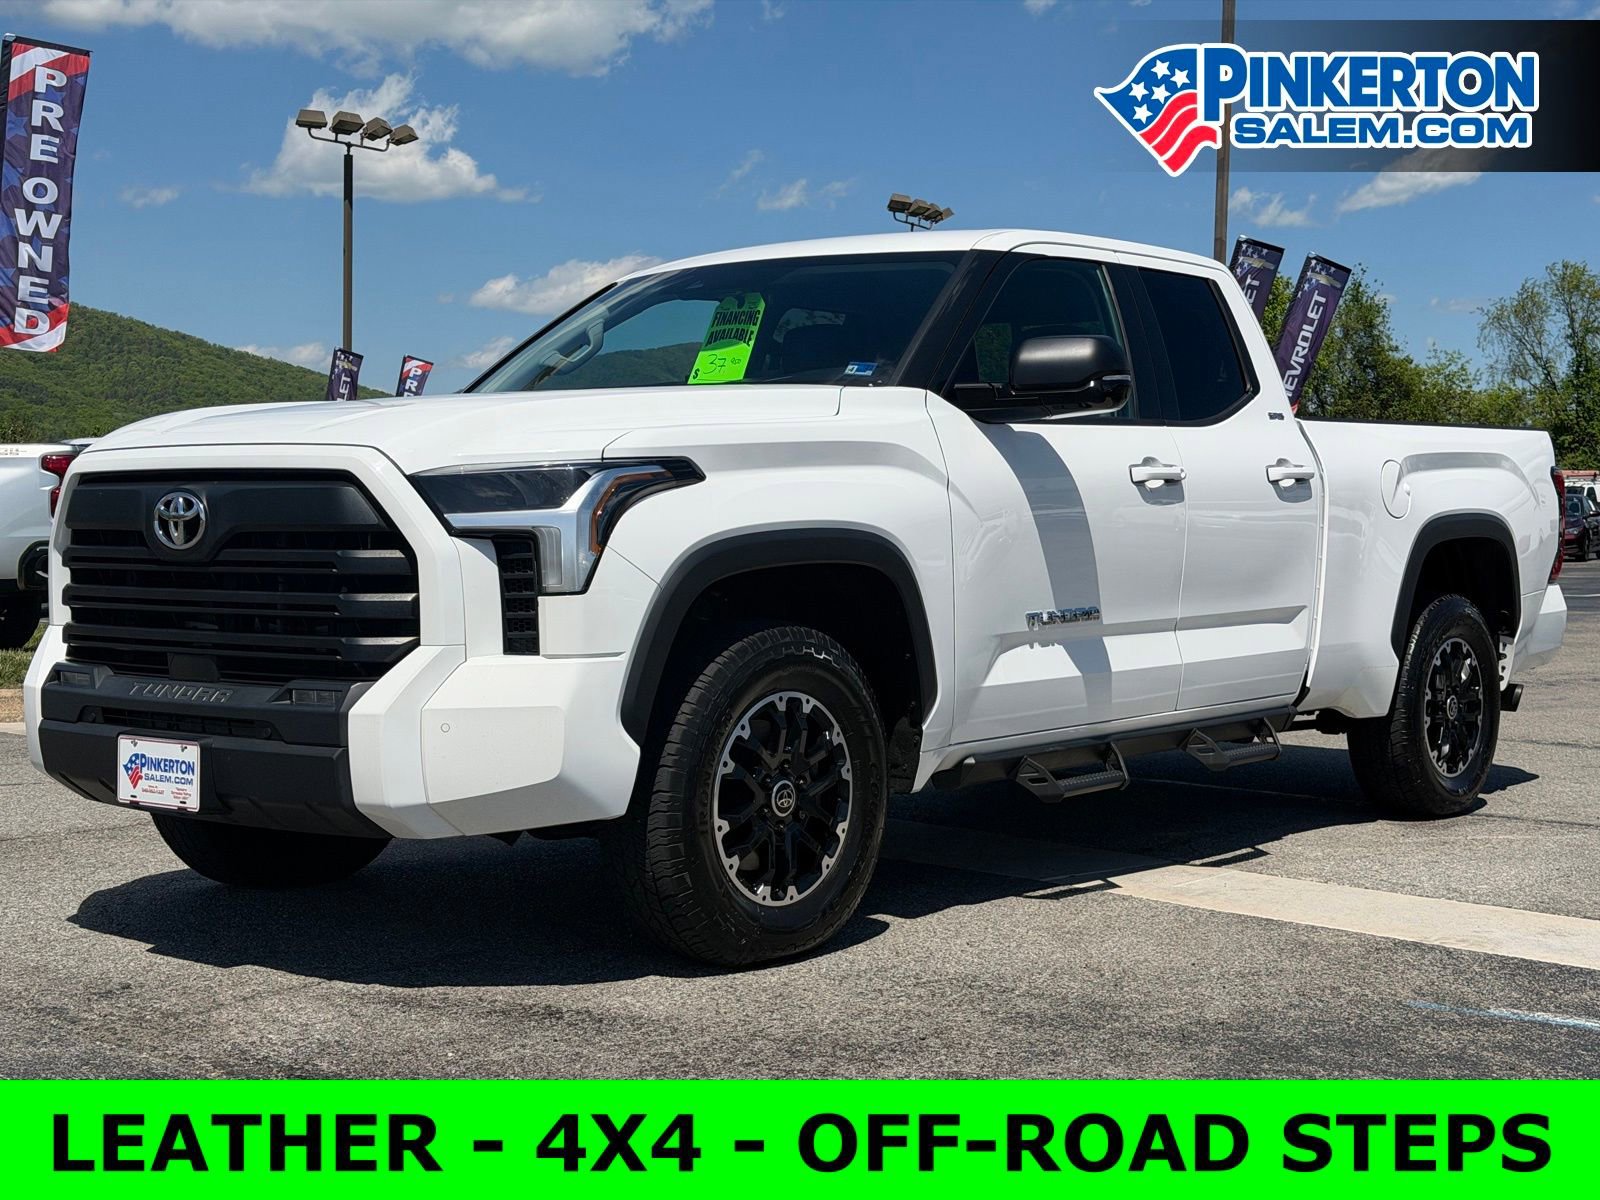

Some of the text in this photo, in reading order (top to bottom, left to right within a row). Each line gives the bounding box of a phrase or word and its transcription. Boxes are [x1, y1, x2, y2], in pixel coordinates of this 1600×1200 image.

[14, 65, 67, 335] PRE OWNED
[711, 309, 760, 328] FINANCING
[704, 328, 754, 347] AVAILABLE
[1025, 606, 1101, 627] TUNDRA
[129, 682, 233, 702] TUNDRA
[140, 753, 195, 776] PINKERTON
[144, 773, 193, 786] SALEM.COM
